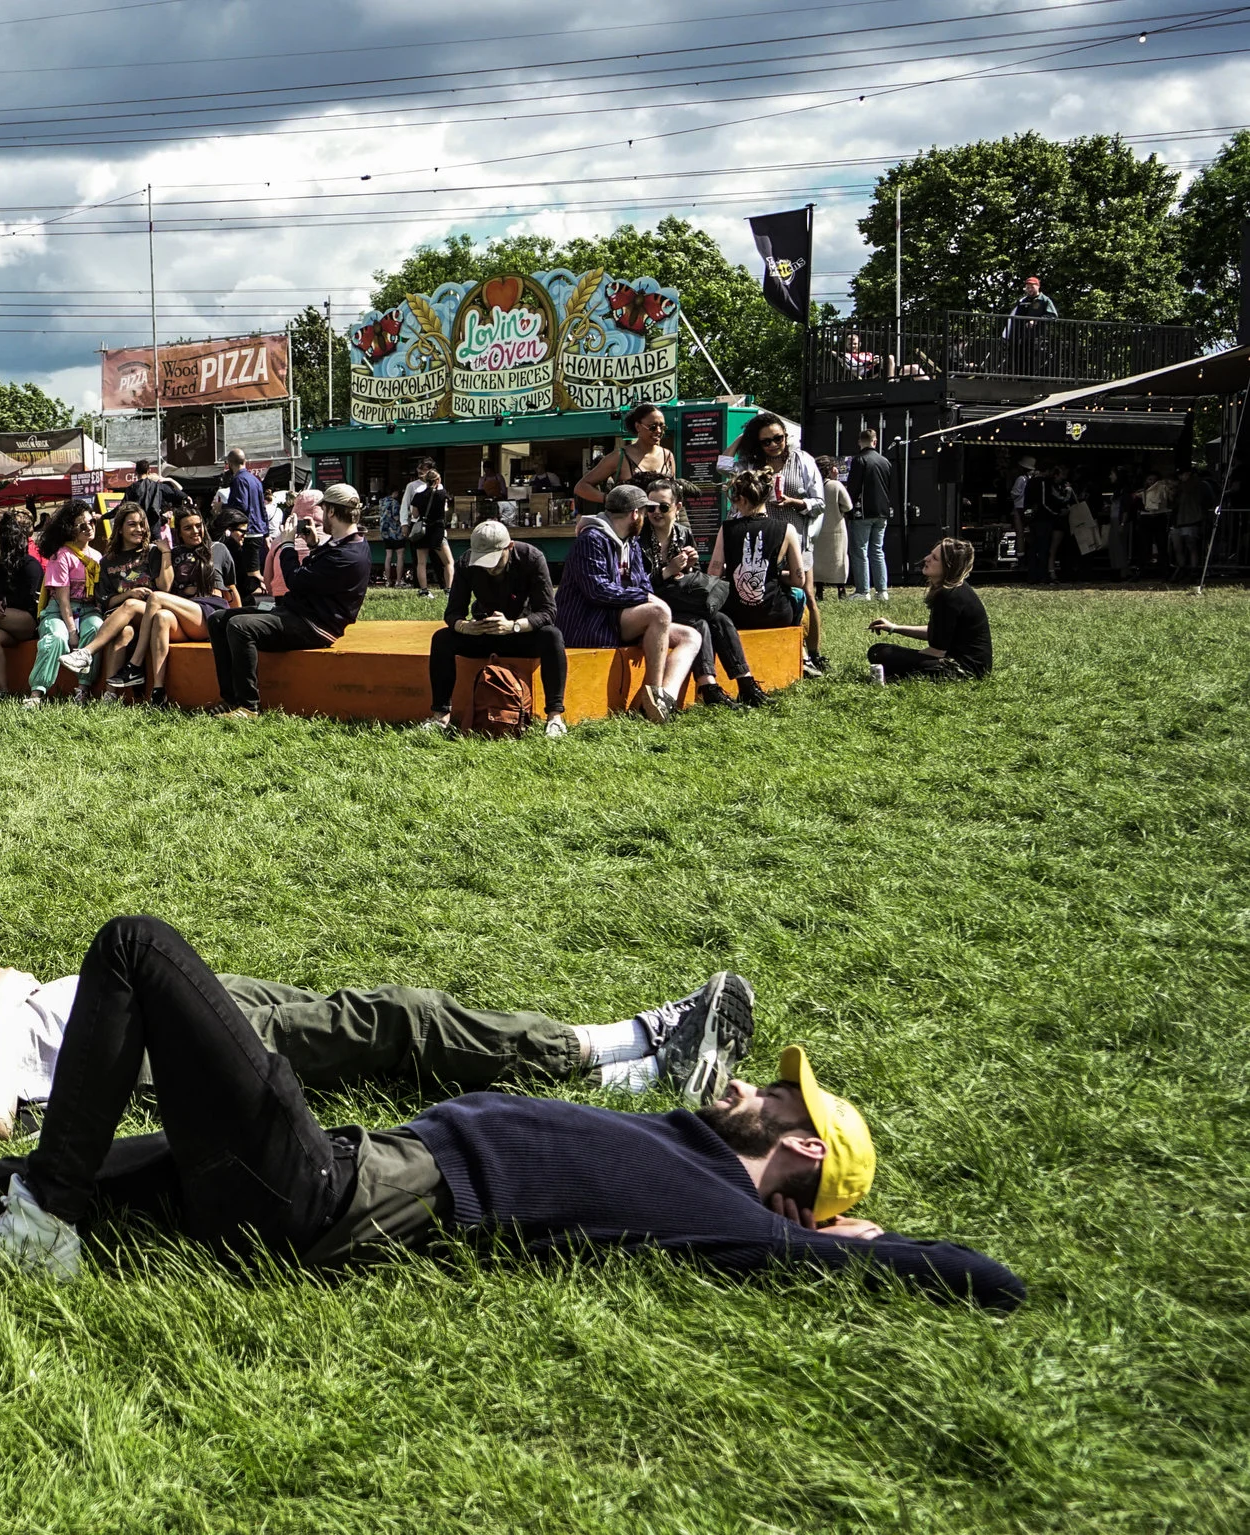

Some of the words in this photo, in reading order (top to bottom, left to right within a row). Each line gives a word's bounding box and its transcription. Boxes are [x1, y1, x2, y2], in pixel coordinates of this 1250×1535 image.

[162, 359, 199, 379] Wood
[474, 354, 488, 369] the
[488, 339, 544, 371] Oven
[565, 348, 669, 378] HOMEMADE
[119, 370, 148, 392] PIZZA
[199, 347, 269, 393] PIZZA
[352, 373, 375, 396] HOT
[375, 368, 445, 398] CHOCOLATE
[453, 372, 505, 390] CHICKEN
[508, 365, 550, 388] PIECES
[162, 377, 198, 397] Fired
[567, 383, 616, 408] PASTA
[619, 379, 673, 407] BAKES
[453, 396, 477, 416] BBQ
[478, 397, 507, 415] RIBS
[519, 388, 551, 411] CHIPS
[91, 472, 100, 484] £8
